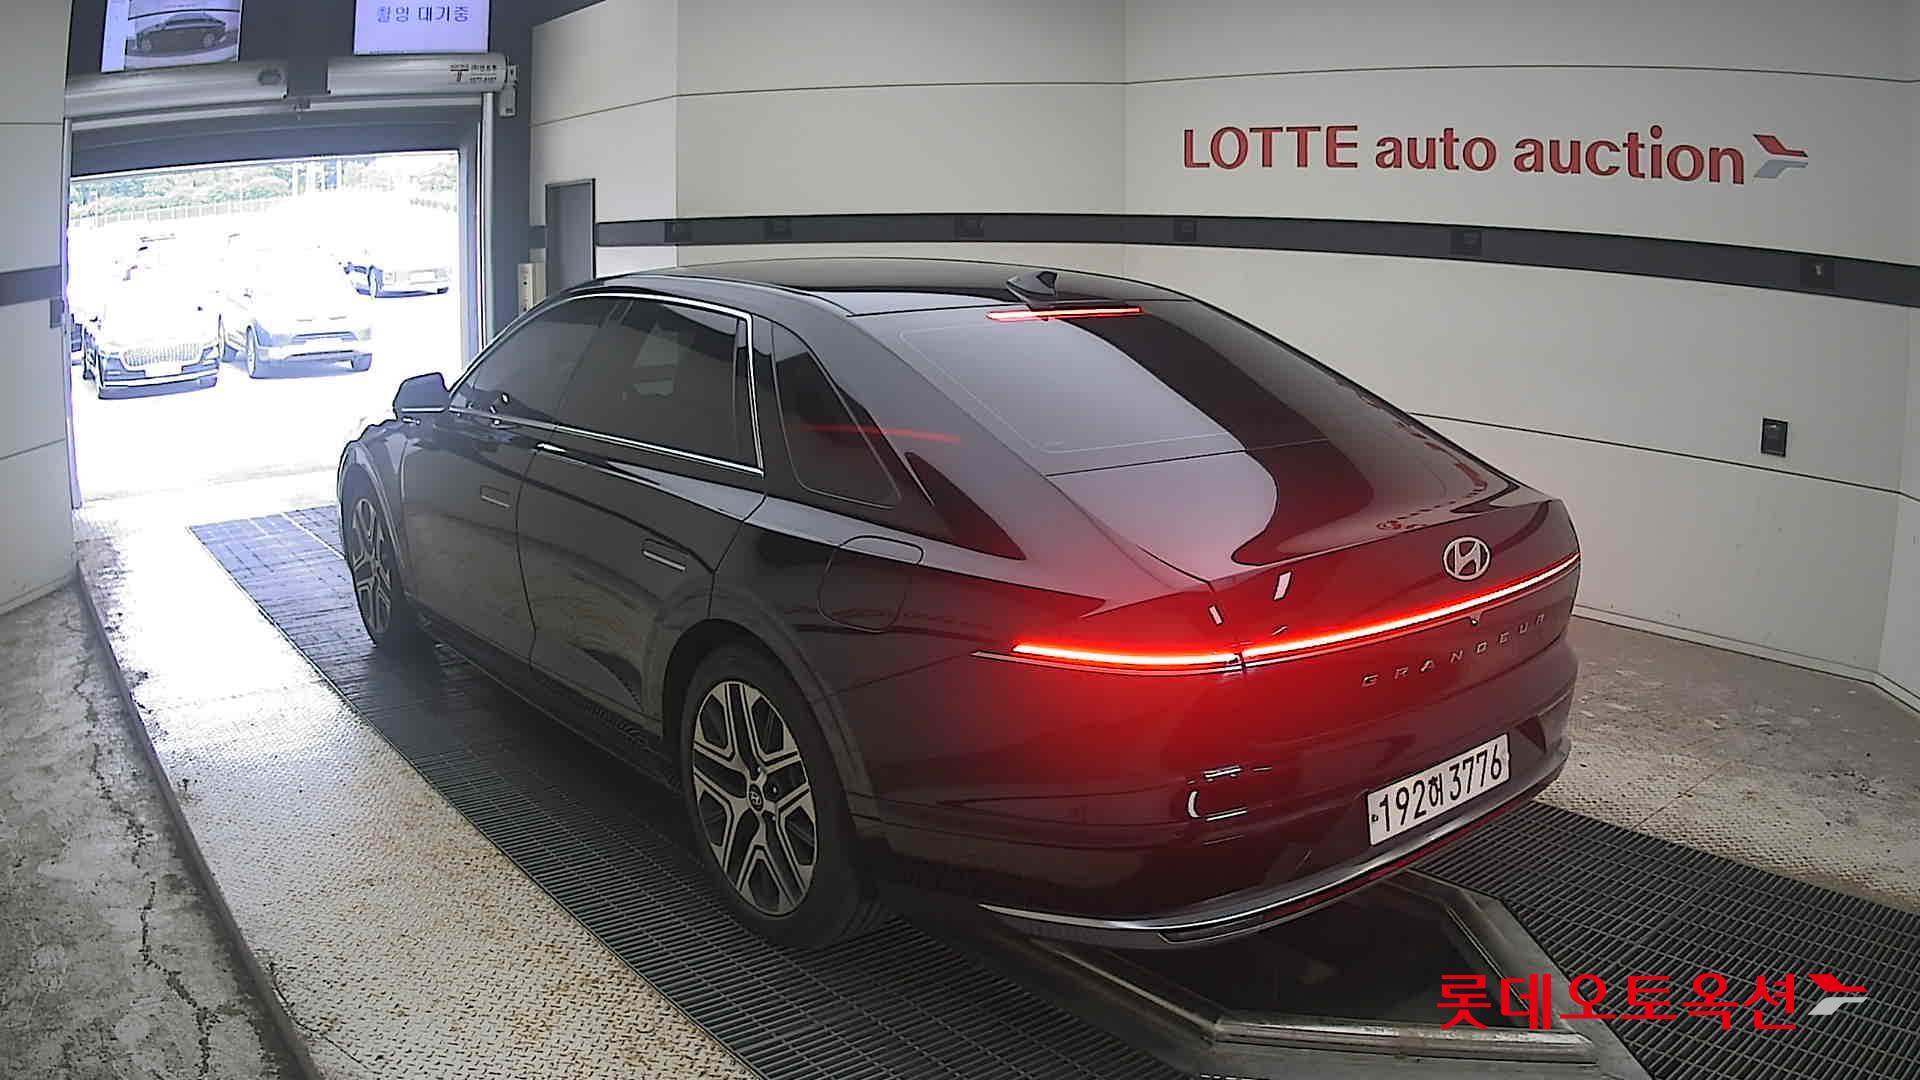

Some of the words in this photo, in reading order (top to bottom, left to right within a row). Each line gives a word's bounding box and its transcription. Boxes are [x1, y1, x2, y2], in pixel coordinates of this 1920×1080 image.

[418, 5, 471, 23] 대기중
[1184, 126, 1359, 169] LOTTE
[1375, 128, 1497, 170] auto
[1513, 125, 1745, 185] auction
[1361, 613, 1545, 688] GRANDEUR
[1448, 744, 1503, 801] 3776
